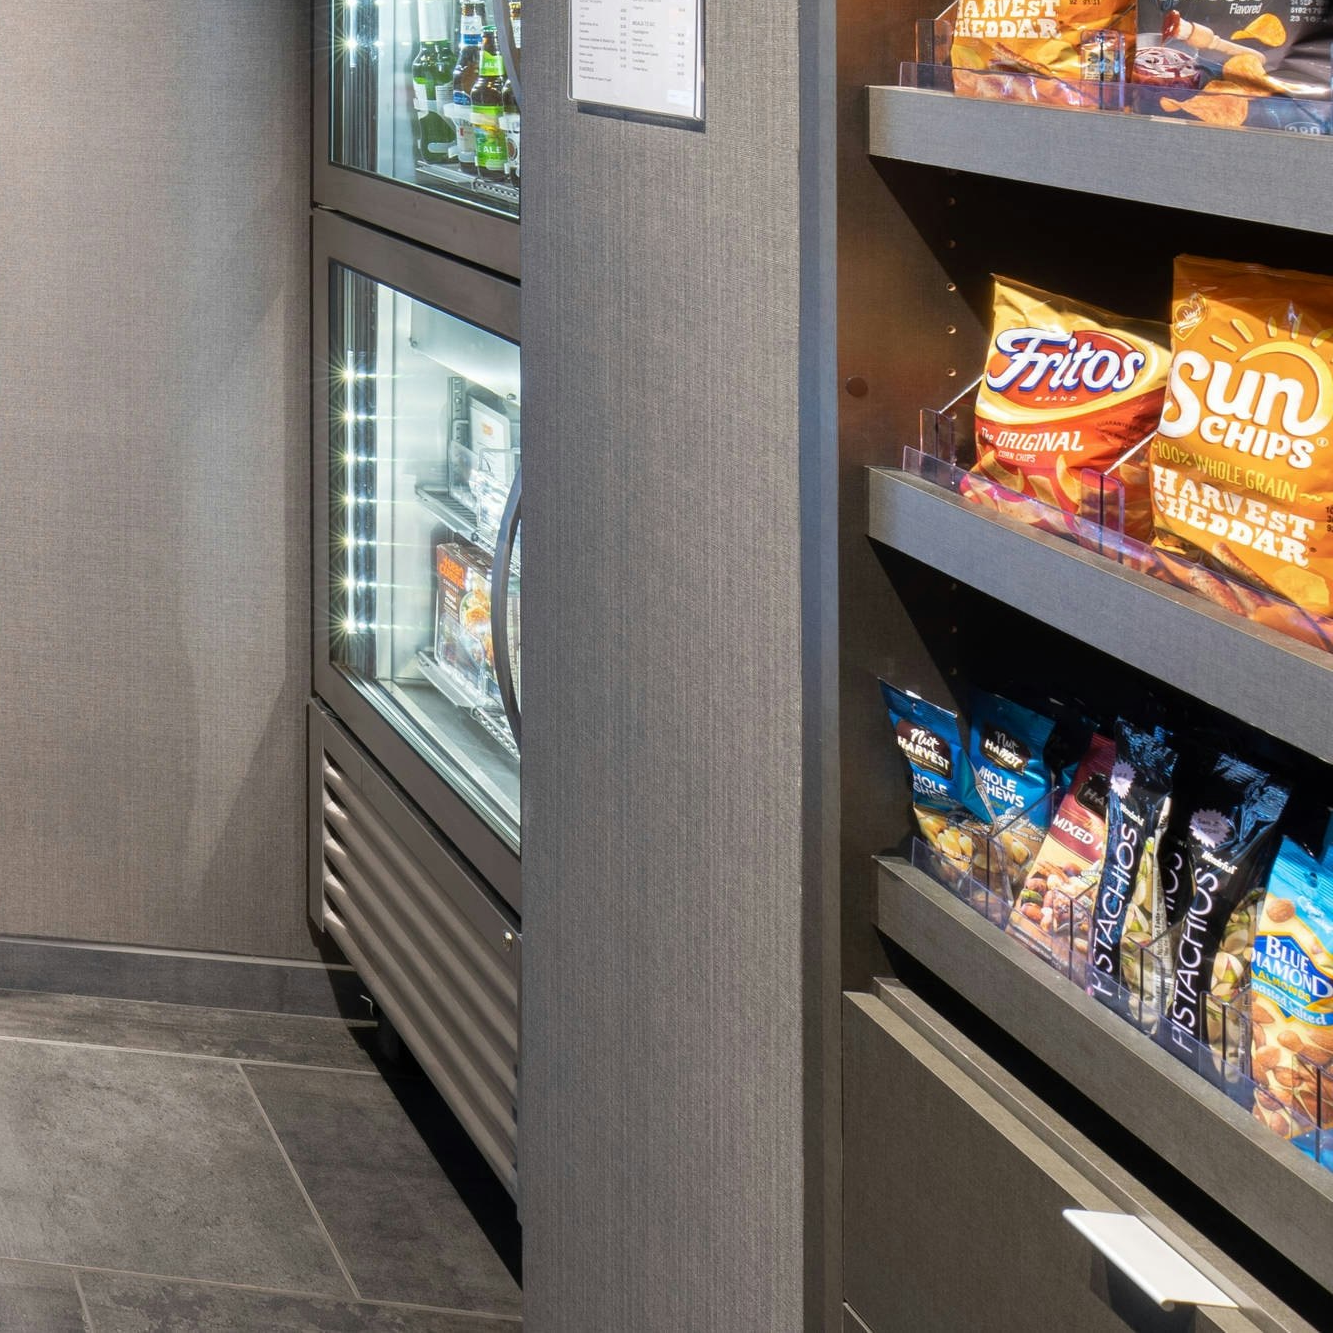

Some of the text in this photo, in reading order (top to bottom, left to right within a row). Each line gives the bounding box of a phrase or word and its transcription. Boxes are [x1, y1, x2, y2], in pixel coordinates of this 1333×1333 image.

[1229, 2, 1264, 15] Flavored
[483, 146, 502, 154] ALE
[985, 326, 1147, 395] Fritos
[1158, 349, 1331, 439] Sun
[981, 426, 994, 444] The
[995, 430, 1085, 453] ORIGINAL
[997, 449, 1037, 464] CORN CHIPS
[1199, 415, 1316, 470] CHIPS
[1158, 440, 1298, 503] 100% WHOLE GRAIN
[1152, 465, 1316, 542] HARVEST
[1153, 491, 1311, 569] CHEDDAR
[897, 735, 950, 771] HARVEST
[910, 727, 940, 753] Nut
[995, 730, 1021, 759] Nut
[913, 772, 948, 798] HOLE
[1052, 814, 1095, 851] MIXED
[1091, 822, 1138, 998] PSTACHIOS
[1265, 934, 1310, 975] BLUE
[1251, 982, 1328, 1027] oasted Salted
[1258, 969, 1312, 1004] ALMONDS
